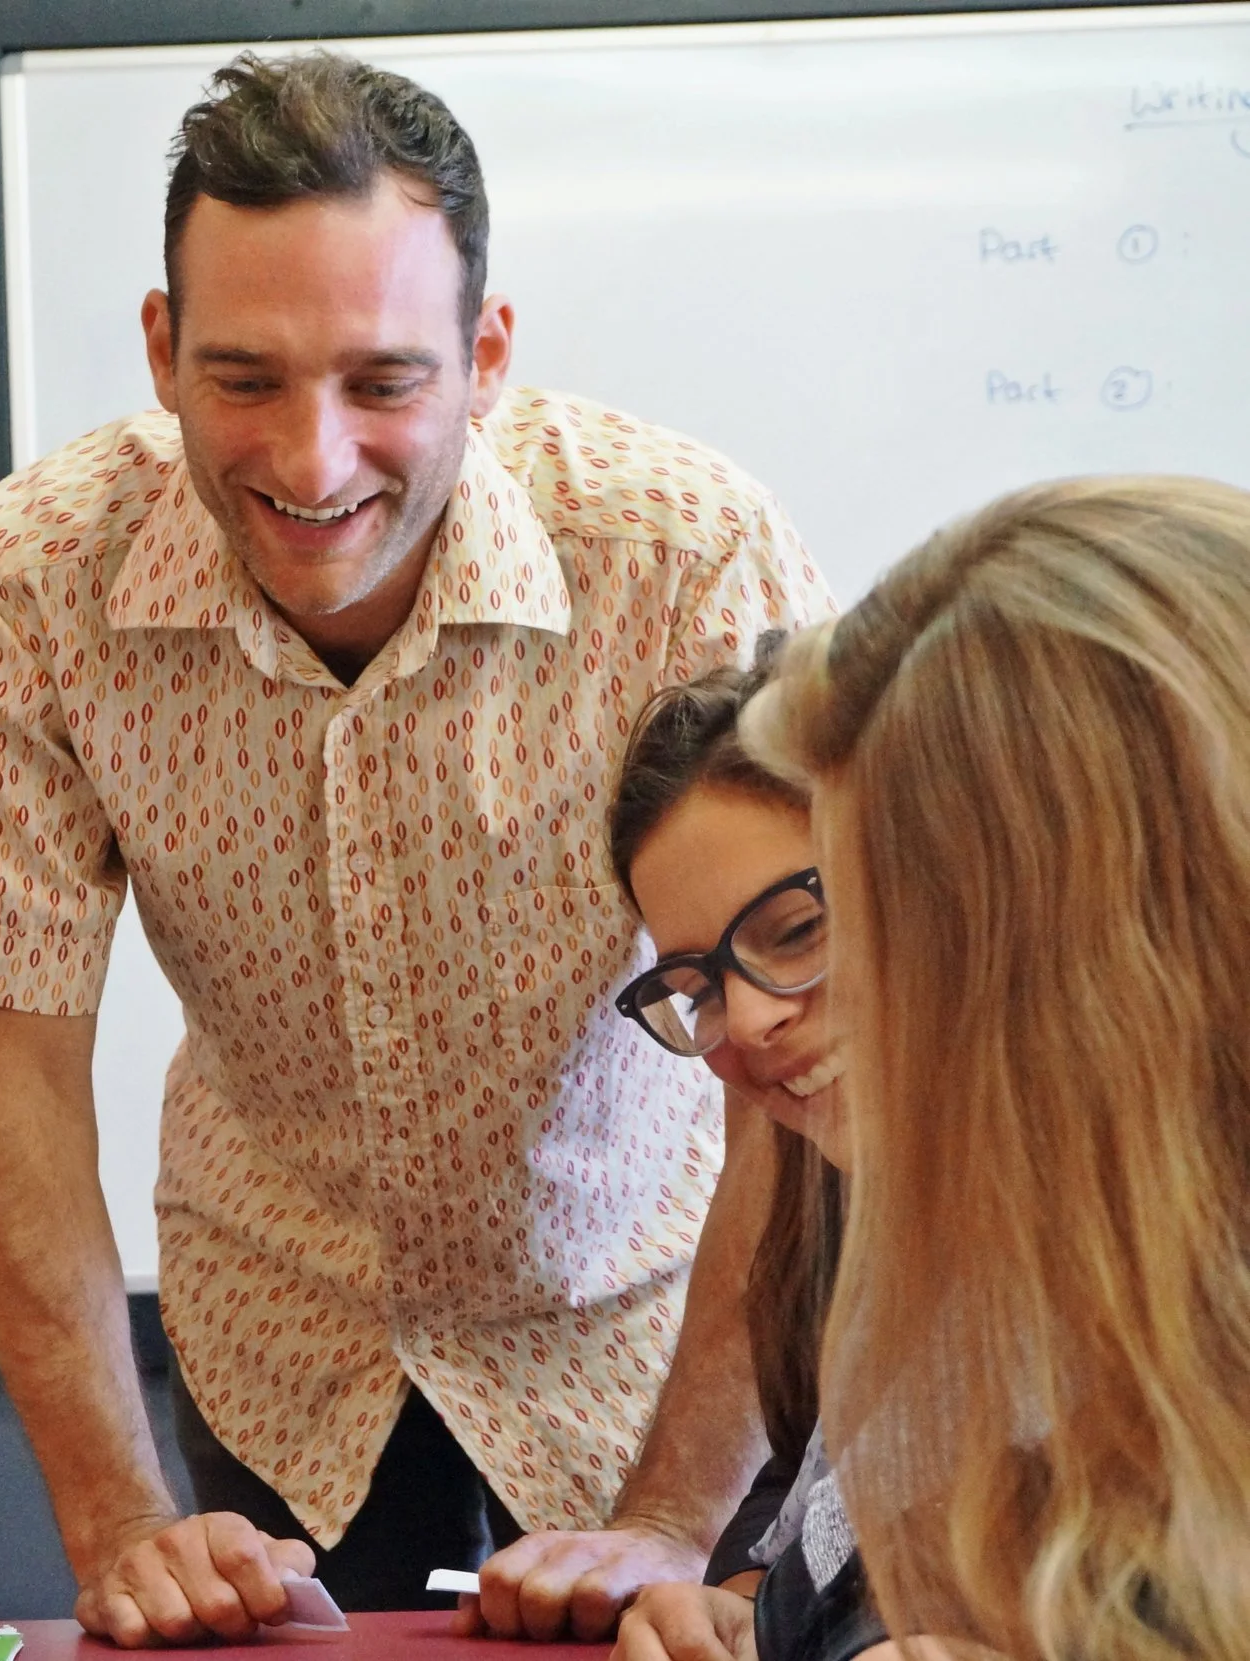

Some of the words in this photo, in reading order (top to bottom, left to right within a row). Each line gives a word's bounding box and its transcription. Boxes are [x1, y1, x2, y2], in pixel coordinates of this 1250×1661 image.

[1131, 76, 1250, 157] Writin
[979, 226, 1059, 263] Part
[986, 369, 1061, 404] Part
